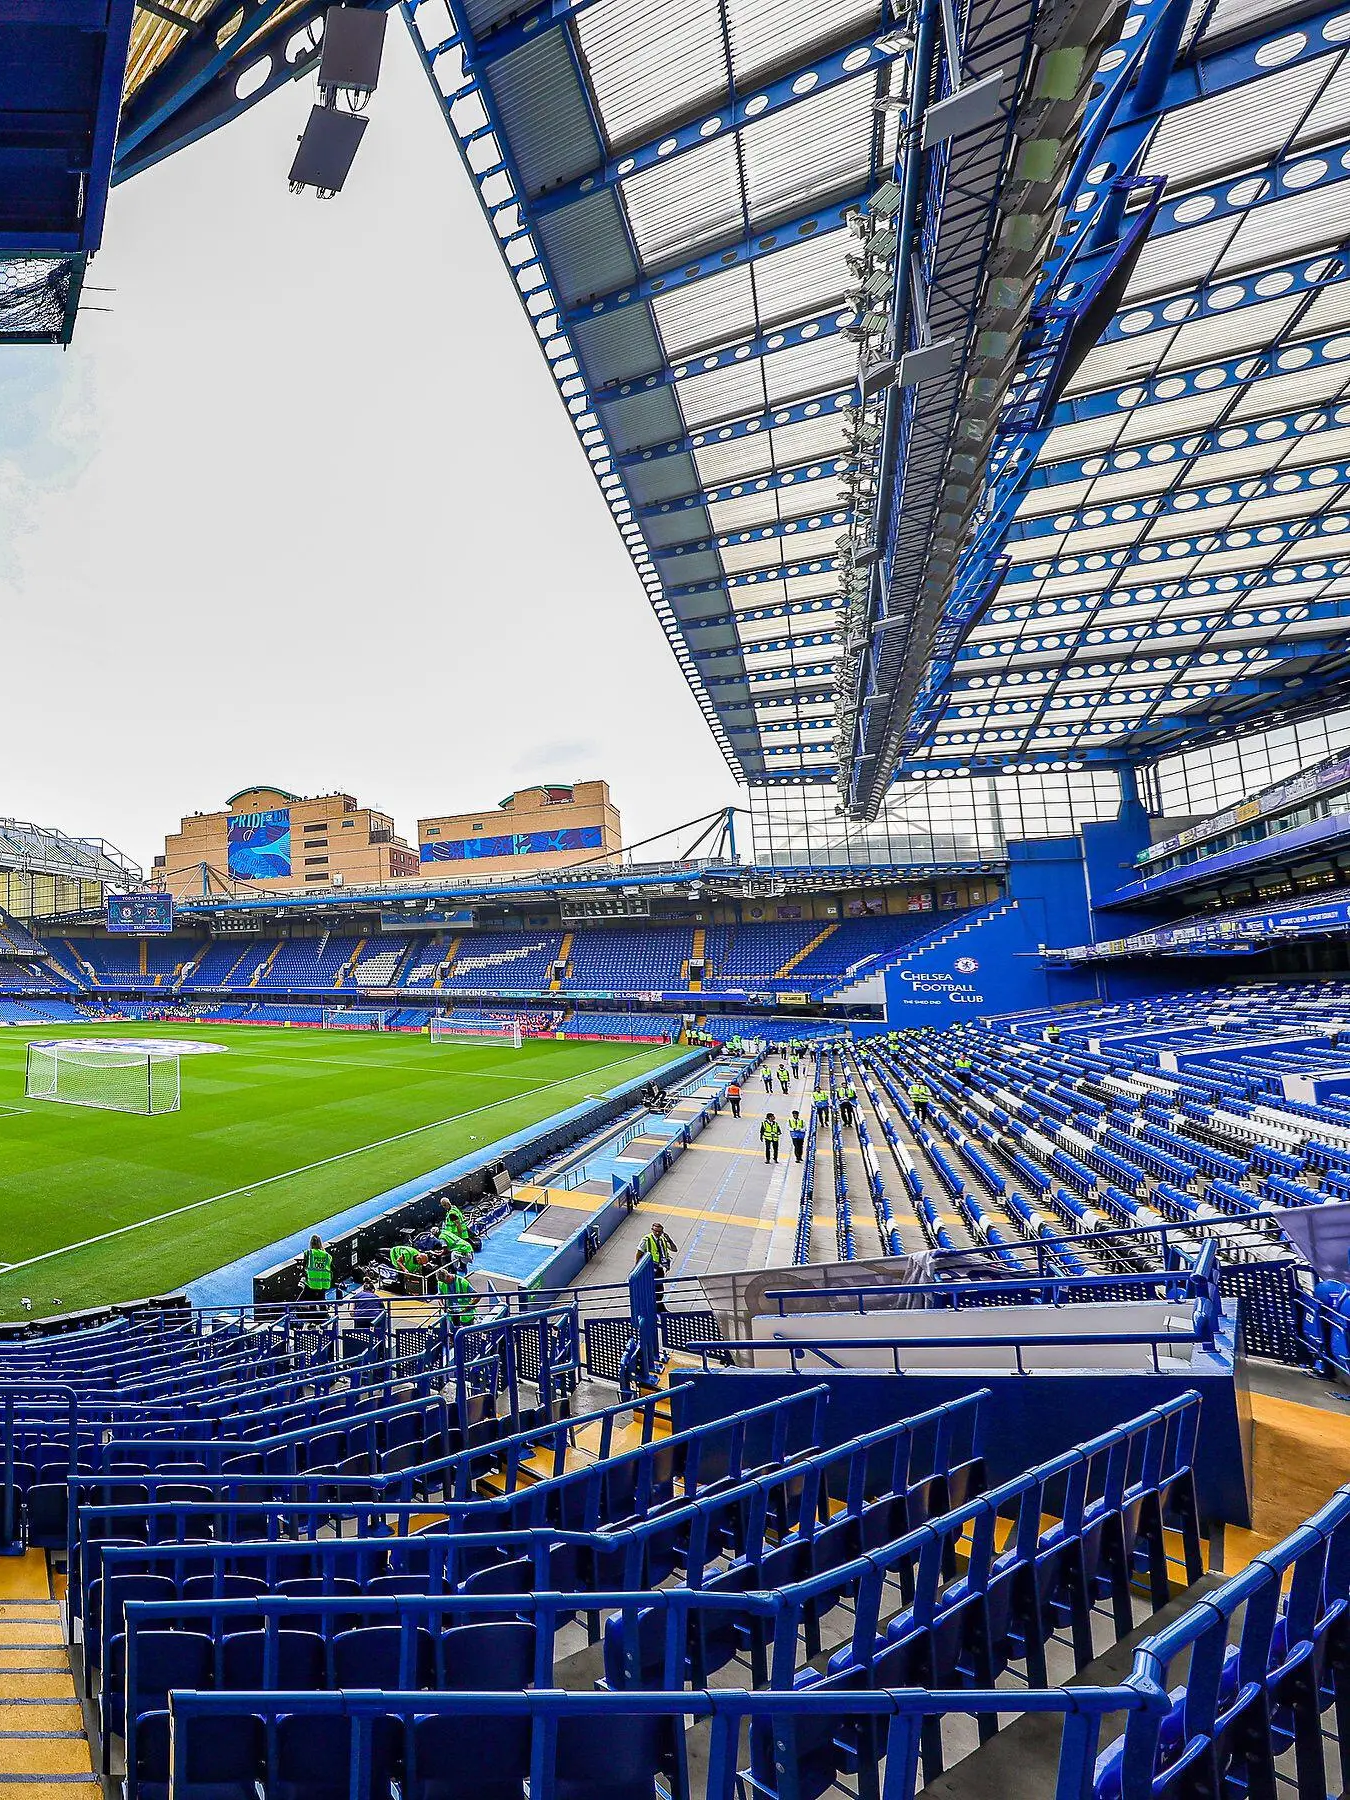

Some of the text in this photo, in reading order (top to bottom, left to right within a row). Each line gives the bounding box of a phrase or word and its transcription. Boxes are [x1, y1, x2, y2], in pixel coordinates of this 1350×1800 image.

[231, 813, 266, 830] PRIDE
[900, 970, 953, 981] CHELSEA
[912, 981, 976, 992] FOOTBALL
[409, 988, 432, 996] BORN
[464, 989, 488, 997] KING
[948, 992, 984, 1003] CLUB
